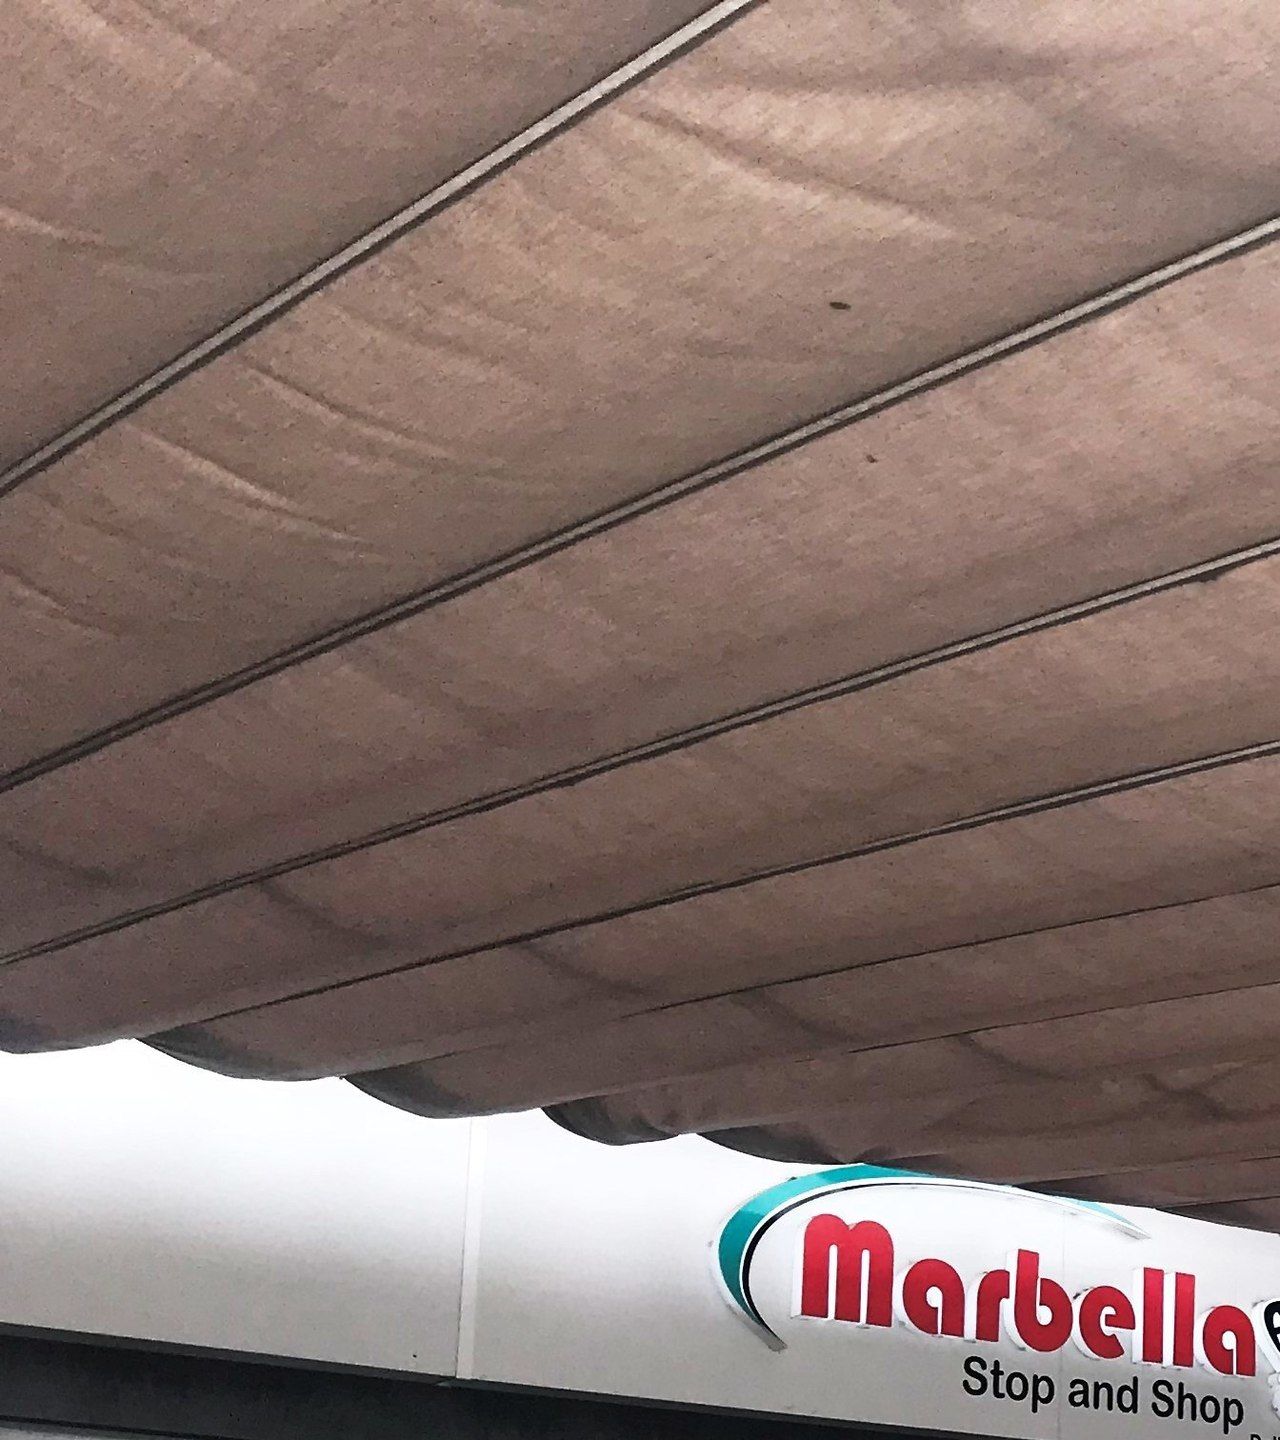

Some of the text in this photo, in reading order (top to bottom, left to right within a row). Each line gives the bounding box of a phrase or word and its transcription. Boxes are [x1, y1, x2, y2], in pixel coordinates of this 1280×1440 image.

[798, 1213, 1257, 1377] Marbella
[962, 1355, 1244, 1435] Stop and Shop
